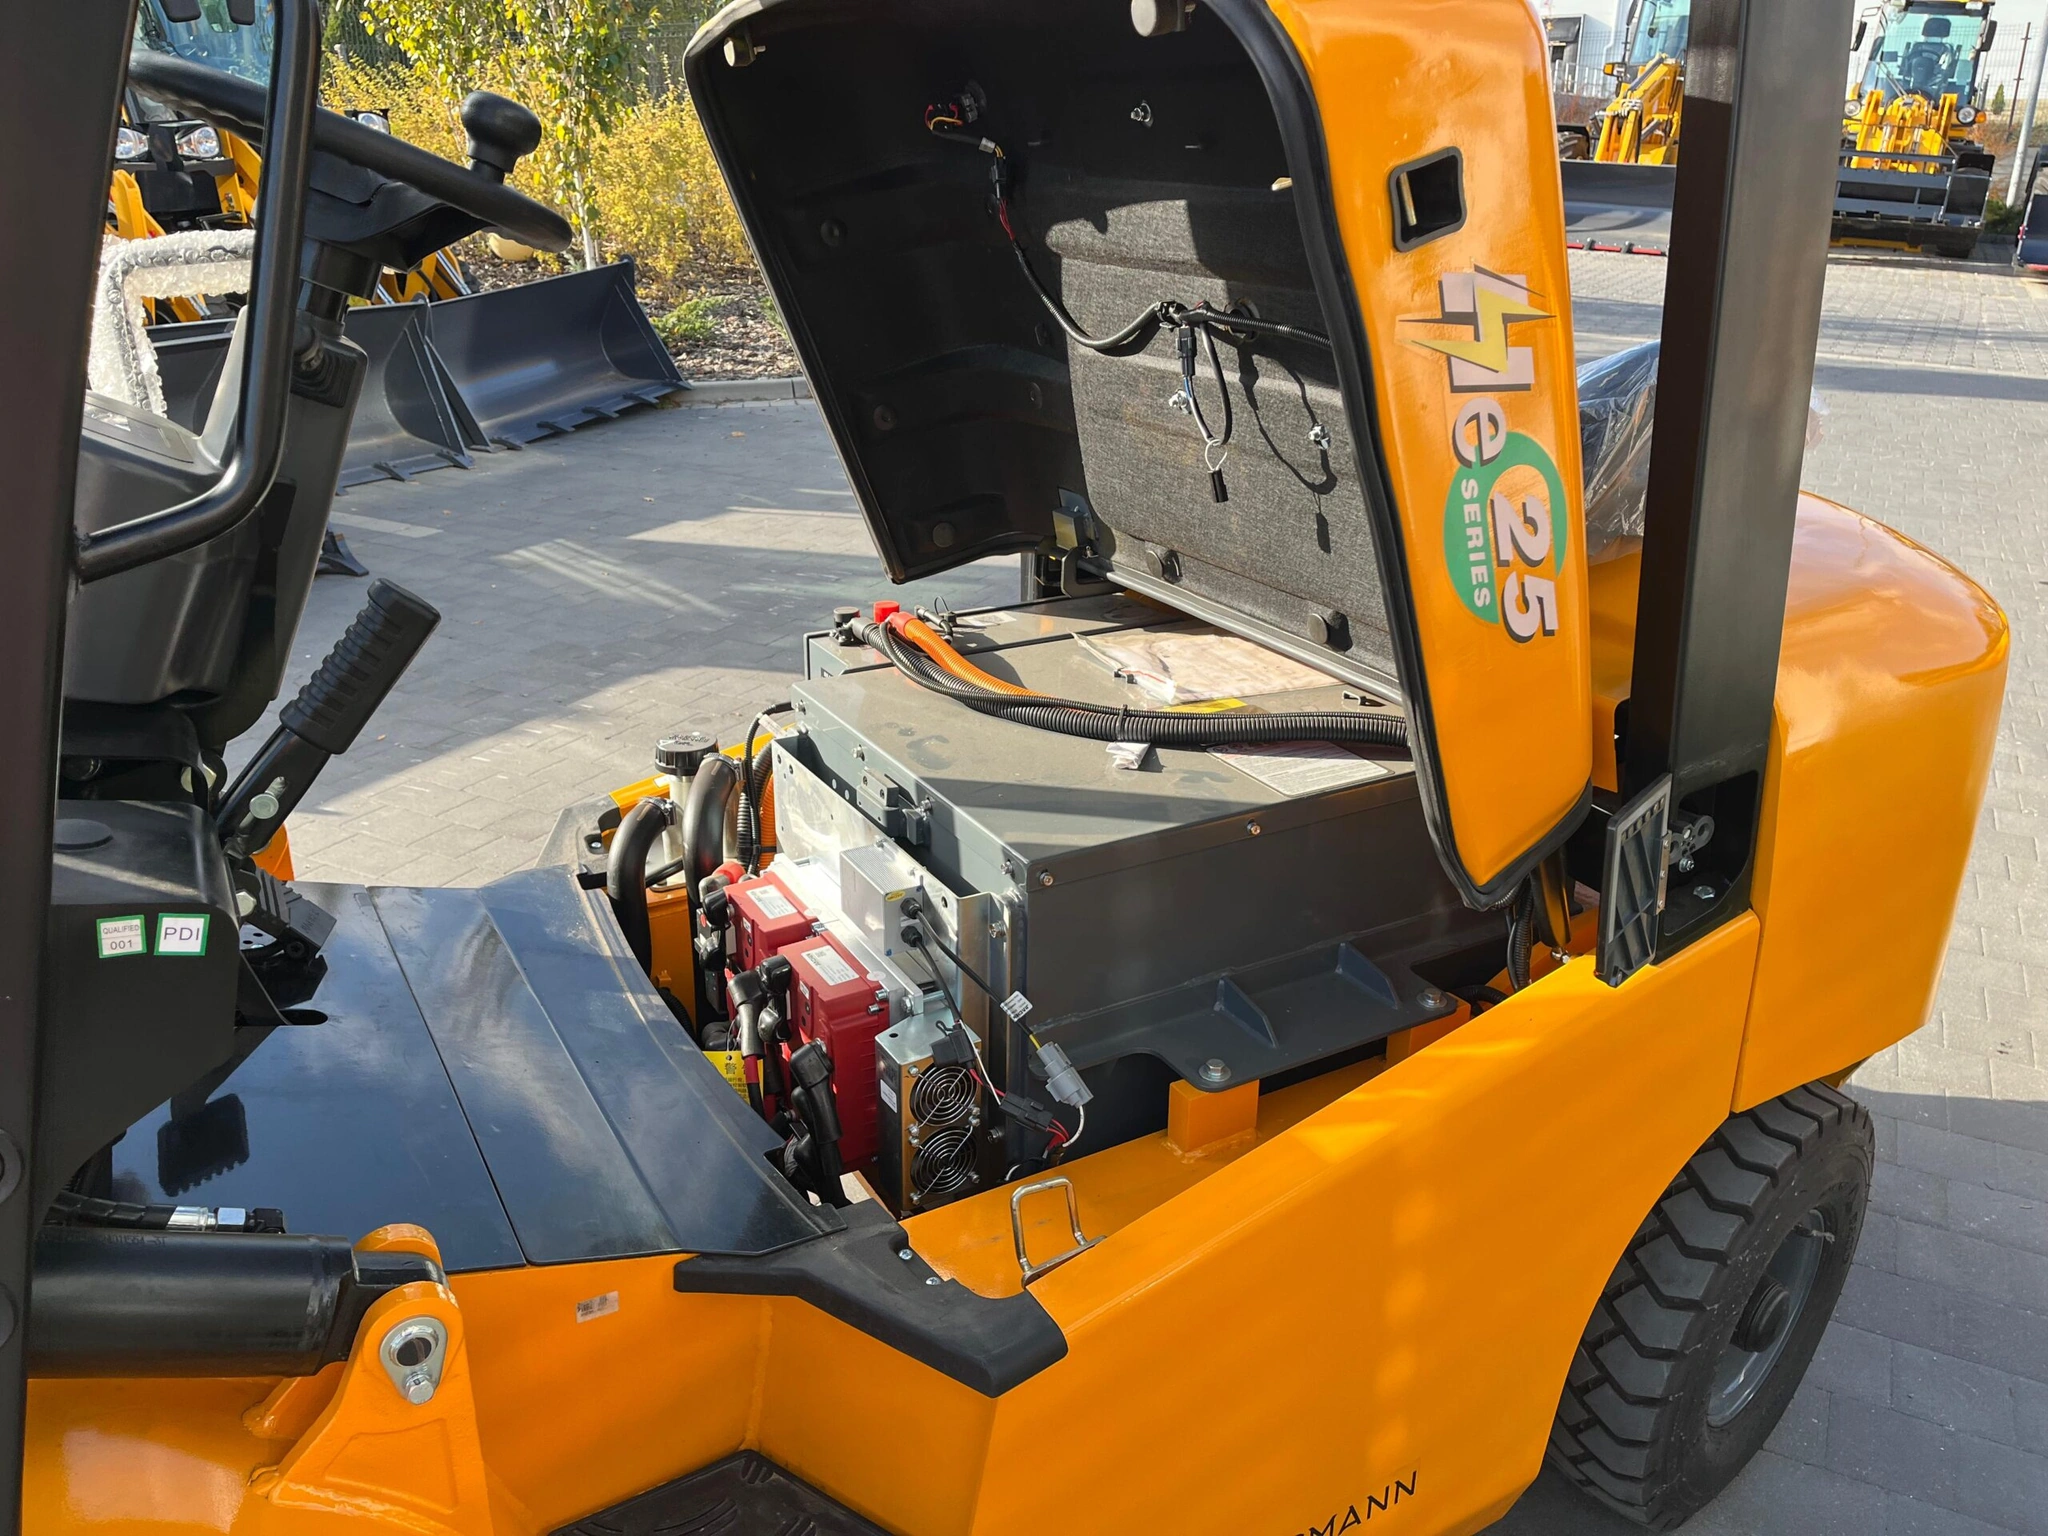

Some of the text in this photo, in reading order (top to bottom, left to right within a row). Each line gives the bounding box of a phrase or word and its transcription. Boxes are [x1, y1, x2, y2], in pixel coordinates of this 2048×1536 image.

[1460, 478, 1492, 608] SERIES
[1490, 490, 1560, 644] 25
[102, 924, 140, 936] QUALIFIED
[109, 939, 133, 951] 001
[163, 926, 200, 941] PDI
[1296, 1470, 1417, 1536] MANN
